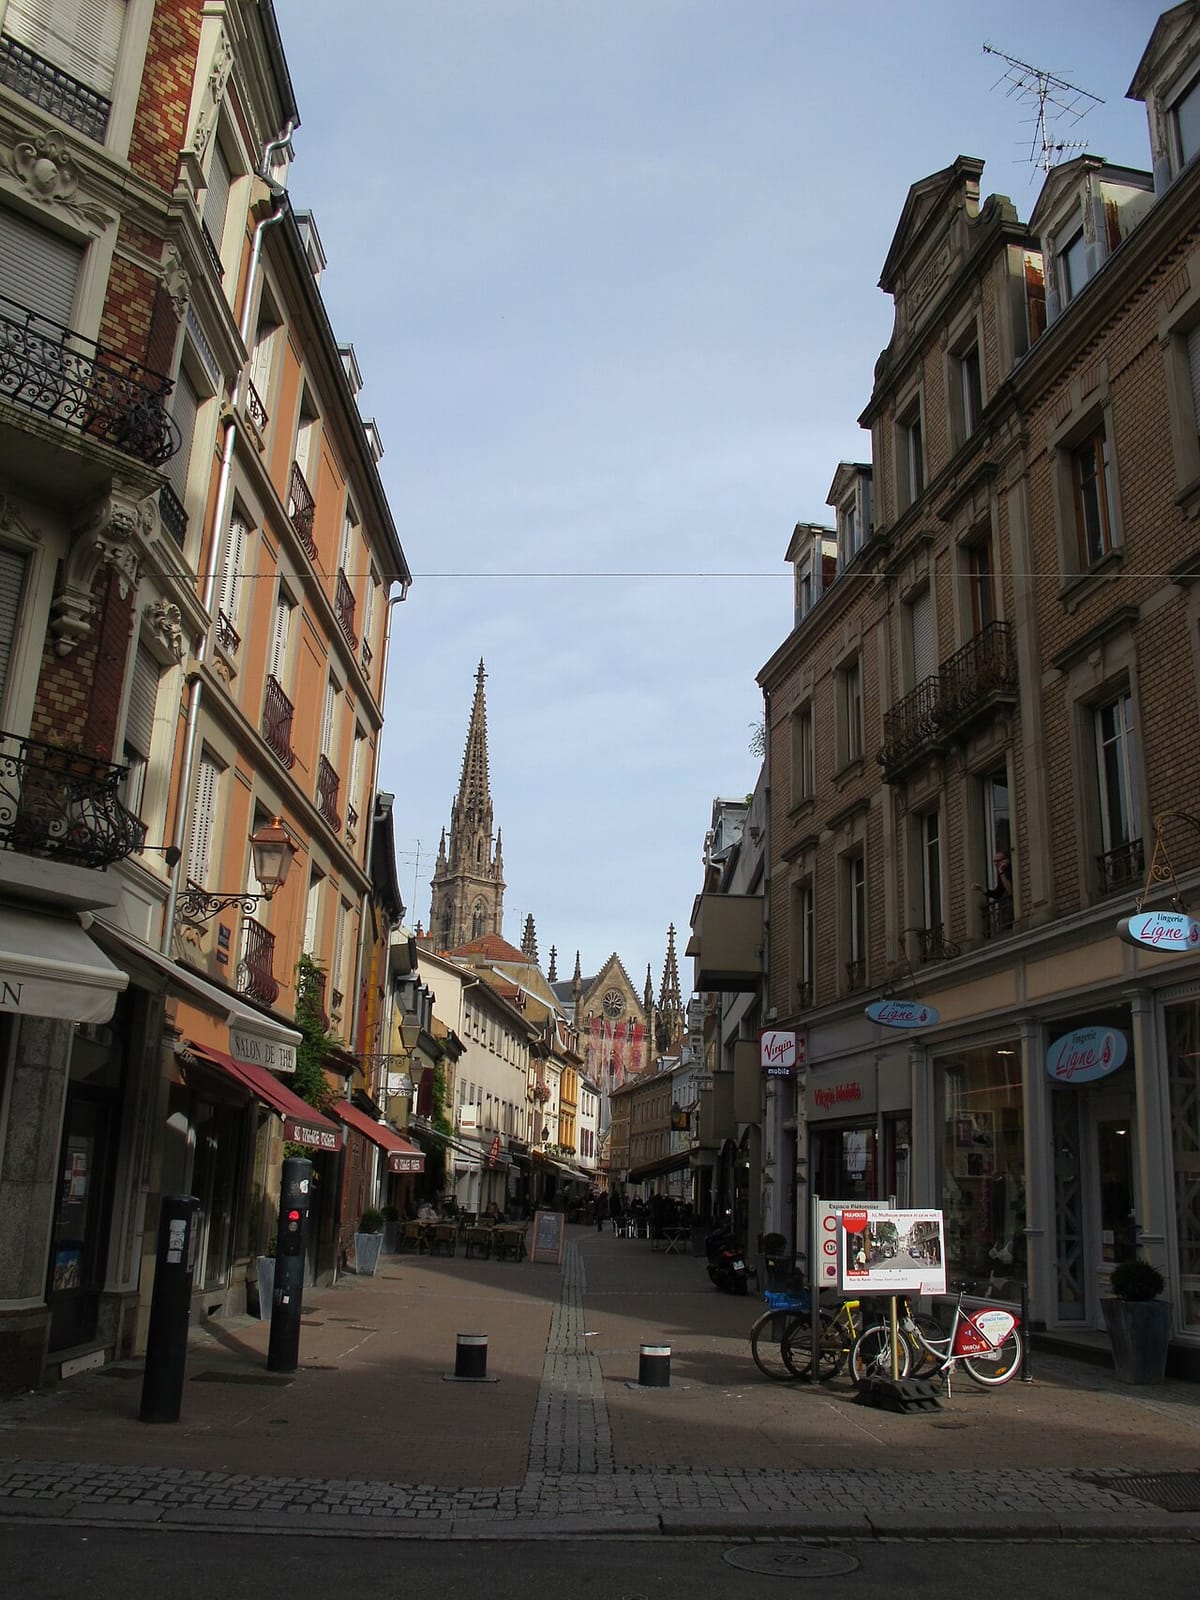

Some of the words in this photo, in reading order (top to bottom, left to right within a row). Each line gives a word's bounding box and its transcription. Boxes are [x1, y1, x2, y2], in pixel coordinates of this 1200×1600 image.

[1157, 913, 1183, 923] lingerie
[235, 1035, 261, 1060] SALON
[265, 1044, 275, 1064] DE
[764, 1034, 794, 1063] Virgin
[767, 1067, 790, 1075] mobile
